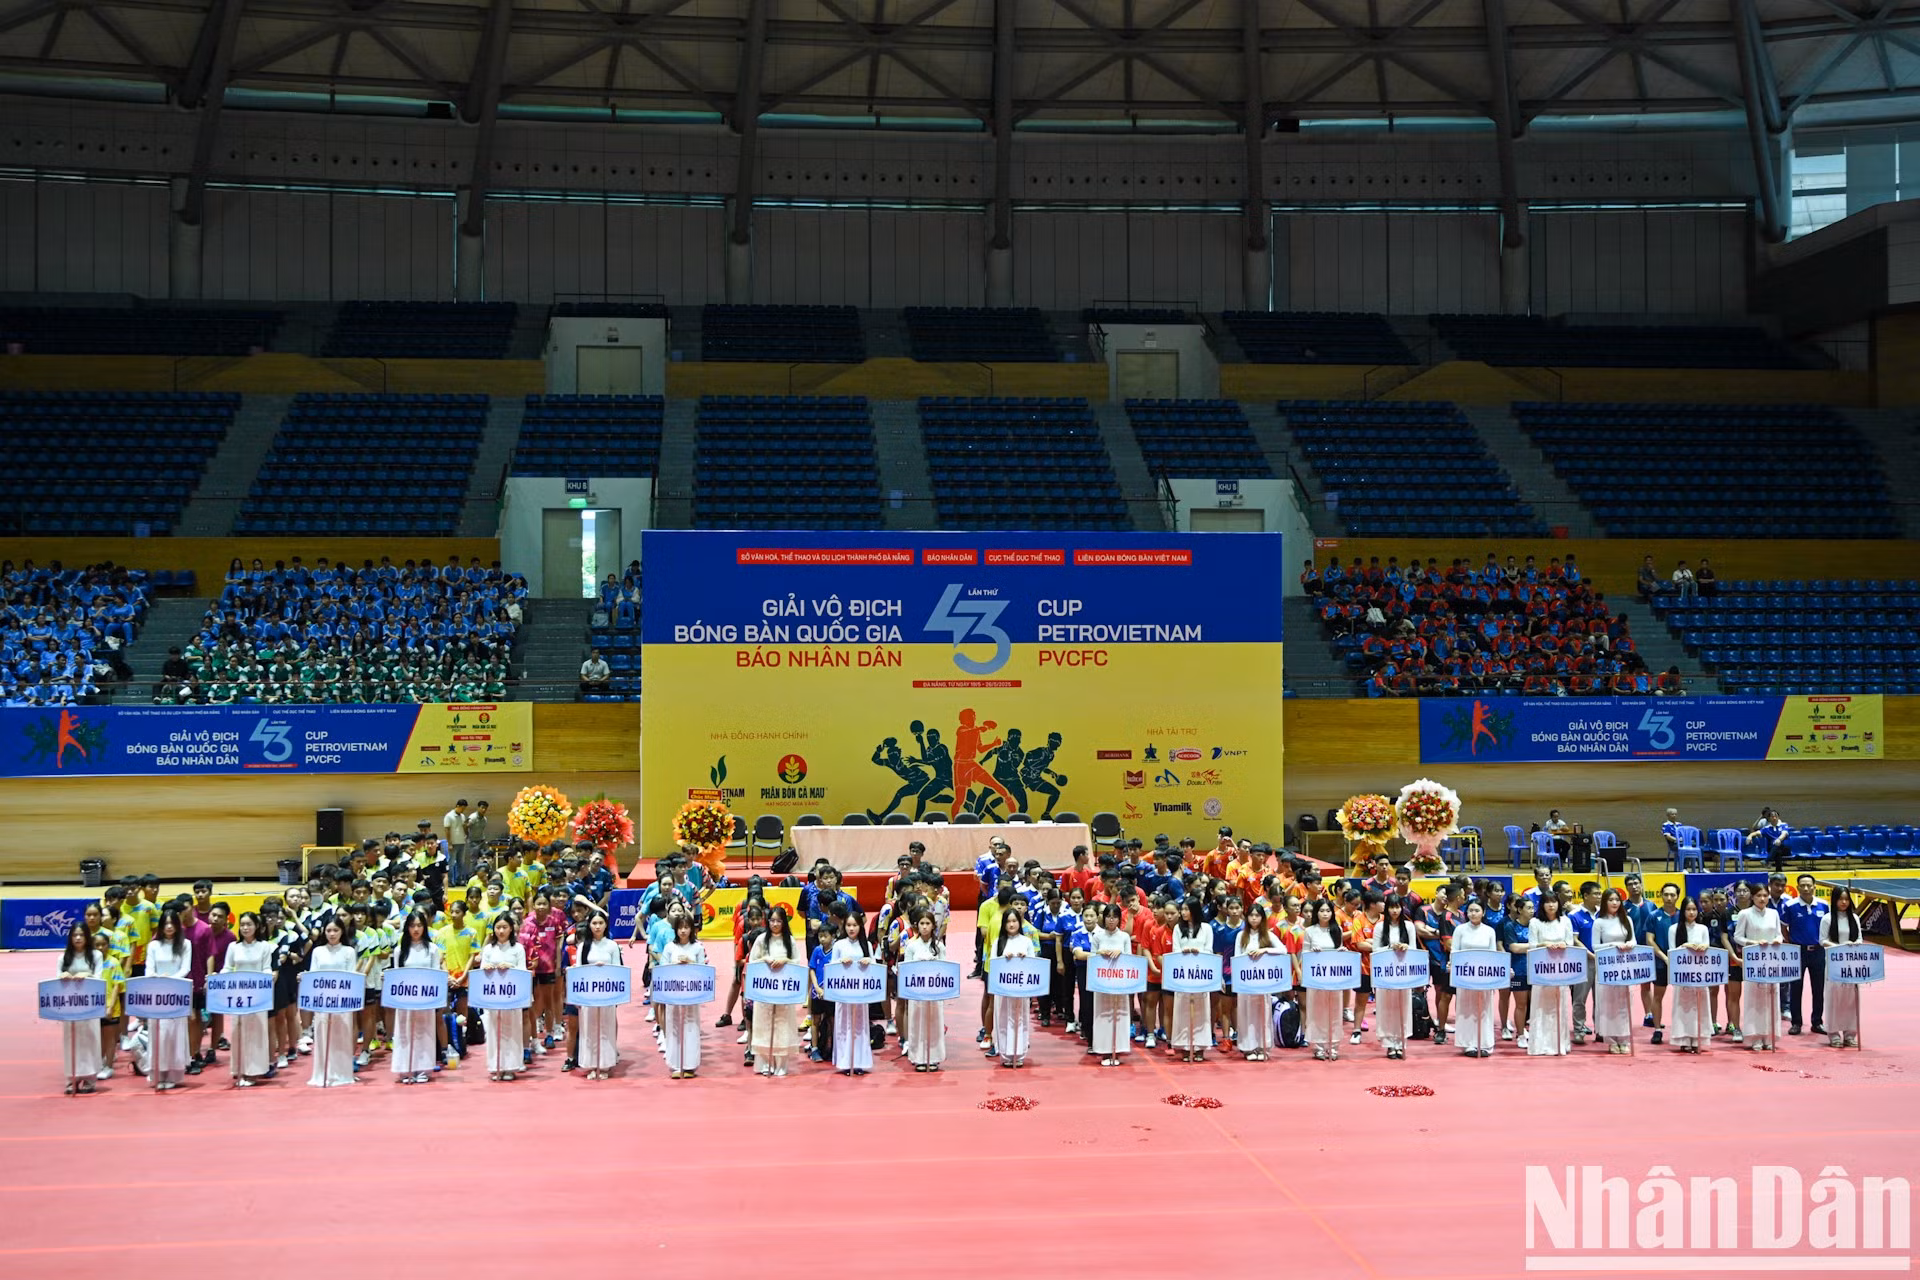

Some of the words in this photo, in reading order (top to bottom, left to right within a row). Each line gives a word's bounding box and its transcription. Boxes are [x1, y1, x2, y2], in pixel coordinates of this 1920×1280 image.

[568, 482, 582, 490] KHU
[1078, 554, 1093, 562] LIÊN
[1172, 554, 1188, 562] NAM
[968, 588, 982, 596] LẦN
[983, 588, 999, 596] THỨ
[762, 592, 804, 617] GIẢI
[812, 594, 842, 617] VÔ
[849, 600, 902, 621] ĐỊCH
[1038, 600, 1083, 617] CUP
[674, 620, 737, 642] BÓNG
[744, 620, 789, 642] BÀN
[796, 617, 859, 643] QUỐC
[866, 625, 903, 642] GIA
[923, 584, 1011, 675] 43
[1038, 625, 1202, 642] PETROVIETNAM
[736, 646, 781, 667] BÁO
[788, 645, 850, 667] NHÂN
[858, 645, 902, 667] DÂN
[1039, 650, 1108, 666] PVCFC
[1568, 719, 1588, 730] GIẢI
[1590, 720, 1603, 730] VÔ
[1605, 722, 1628, 732] ĐỊCH
[1637, 709, 1675, 750] 43
[1686, 721, 1706, 730] CUP
[170, 729, 191, 741] GIẢI
[195, 730, 209, 741] VÔ
[213, 732, 239, 743] ĐỊCH
[249, 718, 293, 762] 43
[305, 731, 328, 740] CUP
[1531, 732, 1559, 742] BÓNG
[1561, 731, 1581, 742] BÀN
[1583, 730, 1611, 742] QUỐC
[1612, 733, 1629, 741] GIA
[1686, 732, 1758, 741] PETROVIETNAM
[127, 742, 158, 754] BÓNG
[160, 742, 184, 754] BÀN
[186, 741, 217, 754] QUỐC
[220, 744, 239, 753] GIA
[306, 742, 388, 752] PETROVIETNAM
[1558, 742, 1577, 753] BÁO
[1580, 742, 1607, 753] NHÂN
[1609, 742, 1629, 753] DÂN
[1686, 743, 1718, 752] PVCFC
[156, 754, 179, 766] BÁO
[182, 754, 214, 765] NHÂN
[216, 754, 239, 765] DÂN
[306, 755, 341, 764] PVCFC
[761, 786, 780, 799] PHÂN
[782, 786, 796, 799] BÓN
[798, 786, 808, 799] CÀ
[810, 787, 825, 799] MAU
[1154, 802, 1192, 812] Vinamilk
[1866, 903, 1883, 930] SPORT
[18, 928, 50, 937] Double
[1677, 954, 1692, 965] CÂU
[1694, 955, 1709, 967] LẠC
[1711, 953, 1721, 967] BỘ
[1747, 952, 1760, 961] CLB
[1761, 952, 1768, 961] P.
[1790, 952, 1799, 960] 10
[1831, 953, 1844, 962] CLB
[1846, 951, 1867, 961] TRÀNG
[1870, 952, 1880, 961] AN
[1097, 968, 1124, 981] TRỌNG
[1126, 967, 1139, 979] TÀI
[1173, 966, 1185, 980] ĐÀ
[1188, 964, 1213, 980] NẴNG
[1240, 966, 1265, 982] QUÂN
[1268, 968, 1283, 982] ĐỘI
[1311, 964, 1328, 977] TÂY
[1330, 966, 1352, 977] NINH
[1374, 966, 1383, 978] TP.
[1396, 964, 1407, 977] CHÍ
[1409, 964, 1427, 976] MINH
[1455, 962, 1475, 977] TIỀN
[1478, 966, 1506, 977] GIANG
[1534, 962, 1556, 974] VĨNH
[1559, 962, 1582, 974] LONG
[1604, 971, 1619, 982] PPP
[1622, 967, 1632, 980] CÀ
[1634, 968, 1651, 980] MAU
[1747, 967, 1756, 978] TP.
[1757, 964, 1766, 978] HỒ
[1769, 963, 1780, 978] CHÍ
[1781, 967, 1799, 977] MINH
[1841, 965, 1853, 978] HÀ
[1856, 965, 1871, 980] NỘI
[208, 980, 226, 990] CÔNG
[228, 980, 238, 990] AN
[239, 979, 258, 990] NHÂN
[259, 979, 272, 989] DÂN
[313, 977, 337, 989] CÔNG
[339, 980, 352, 990] AN
[653, 977, 663, 992] HẢI
[703, 976, 714, 992] HẢI
[752, 977, 779, 990] HƯNG
[782, 978, 800, 992] YÊN
[827, 976, 860, 990] KHÁNH
[863, 976, 882, 990] HÒA
[905, 975, 925, 988] LÂM
[928, 972, 955, 988] ĐỒNG
[999, 971, 1024, 987] NGHỆ
[1027, 974, 1040, 985] AN
[1674, 972, 1702, 983] TIMES
[1704, 972, 1725, 983] CITY
[391, 981, 418, 997] ĐỒNG
[421, 986, 439, 997] NAI
[483, 983, 496, 996] HÀ
[500, 984, 516, 999] NỘI
[573, 978, 589, 993] HẢI
[592, 978, 625, 993] PHÒNG
[40, 993, 51, 1008] BÀ
[53, 992, 89, 1010] RỊA-VŨNG
[91, 992, 106, 1006] TÀU
[128, 993, 152, 1006] BÌNH
[156, 994, 190, 1006] DƯƠNG
[228, 997, 232, 1008] T
[236, 997, 243, 1008] &
[247, 997, 253, 1008] T
[301, 996, 311, 1008] TP.
[313, 993, 324, 1008] HỒ
[326, 994, 339, 1008] CHÍ
[341, 997, 362, 1009] MINH
